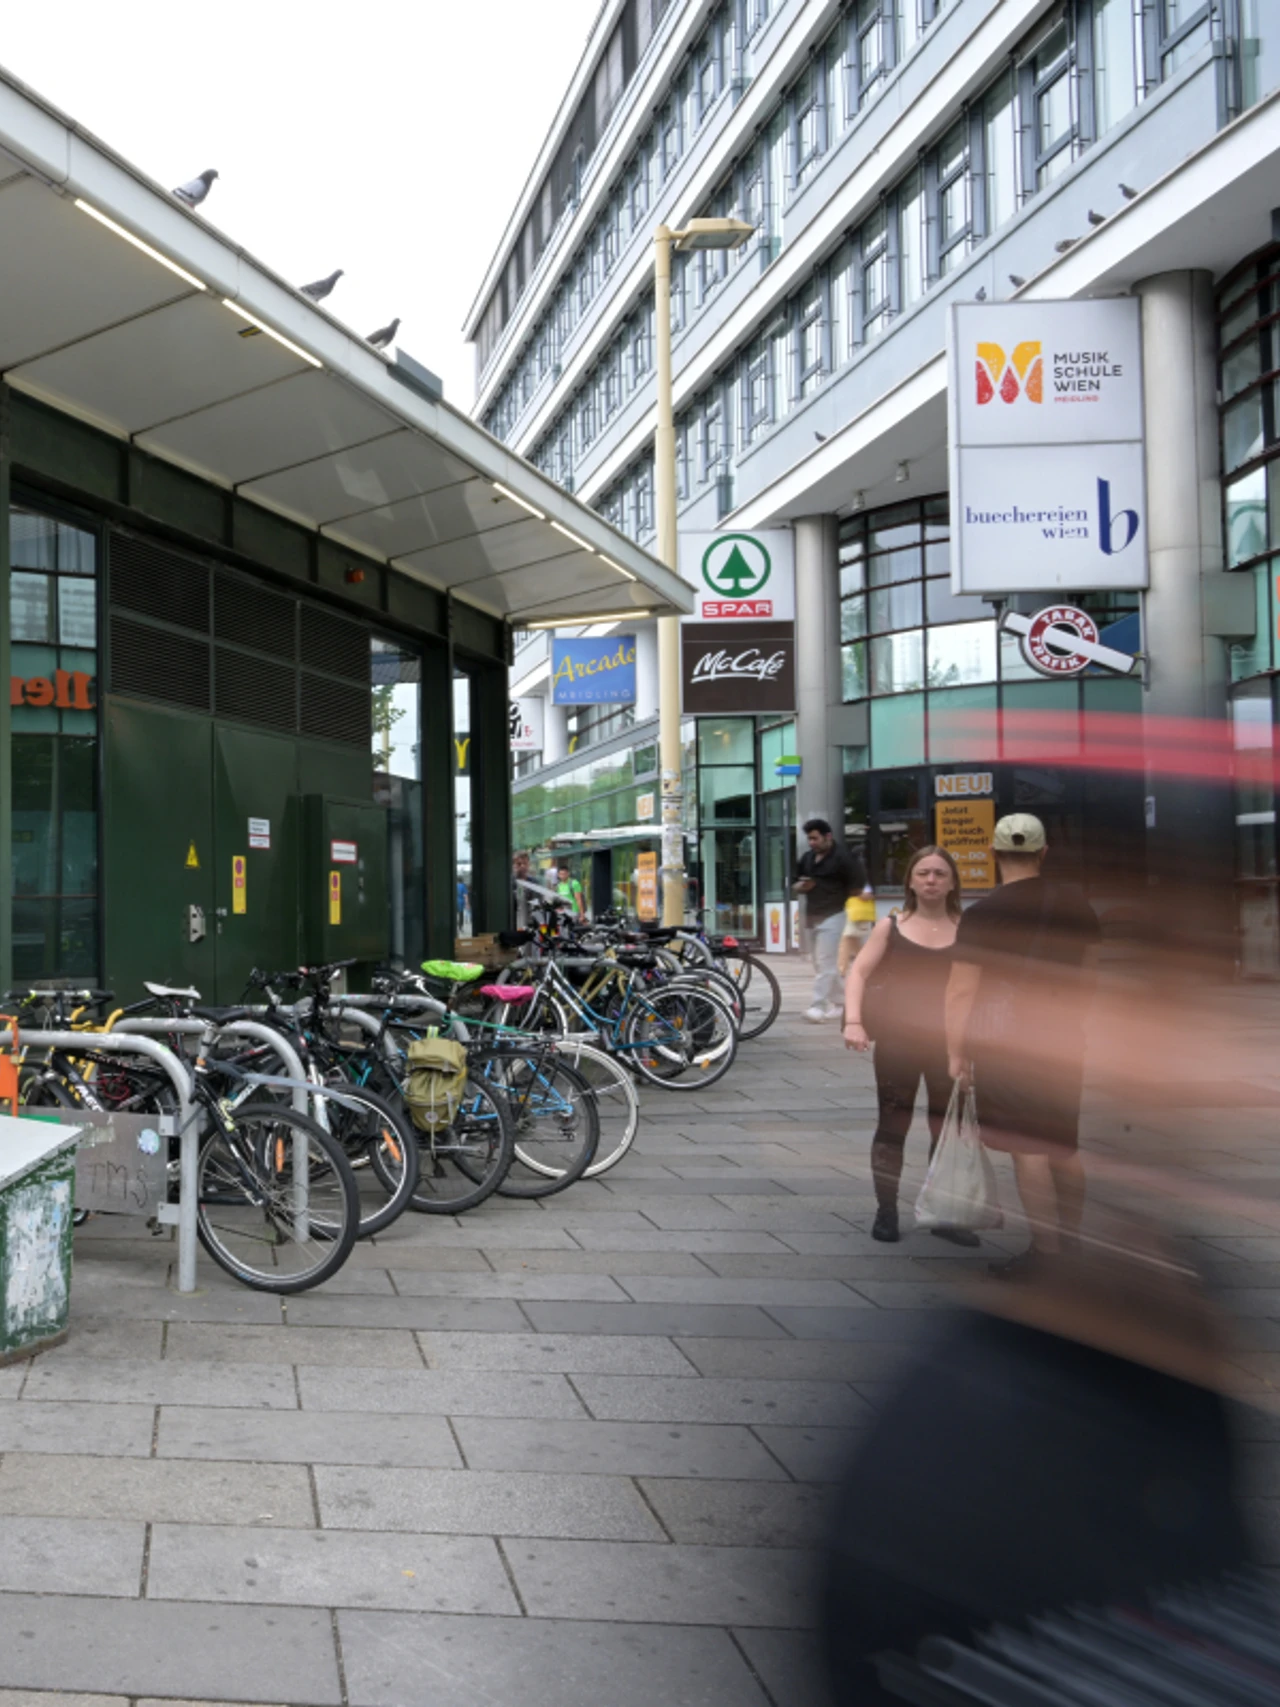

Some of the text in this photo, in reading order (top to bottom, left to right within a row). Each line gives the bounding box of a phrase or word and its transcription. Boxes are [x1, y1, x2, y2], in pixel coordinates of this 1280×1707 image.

[1053, 352, 1110, 364] MUSIK
[1053, 365, 1123, 379] SCHULE
[1053, 380, 1101, 392] WIEN
[965, 505, 1088, 525] buechereien
[1041, 523, 1090, 539] wien
[703, 603, 771, 616] SPAR
[1040, 609, 1096, 637] TABAK
[1030, 635, 1081, 669] TRAFIK
[553, 644, 636, 689] Arcade
[559, 689, 631, 699] MEIDLING
[937, 774, 991, 794] NEU!
